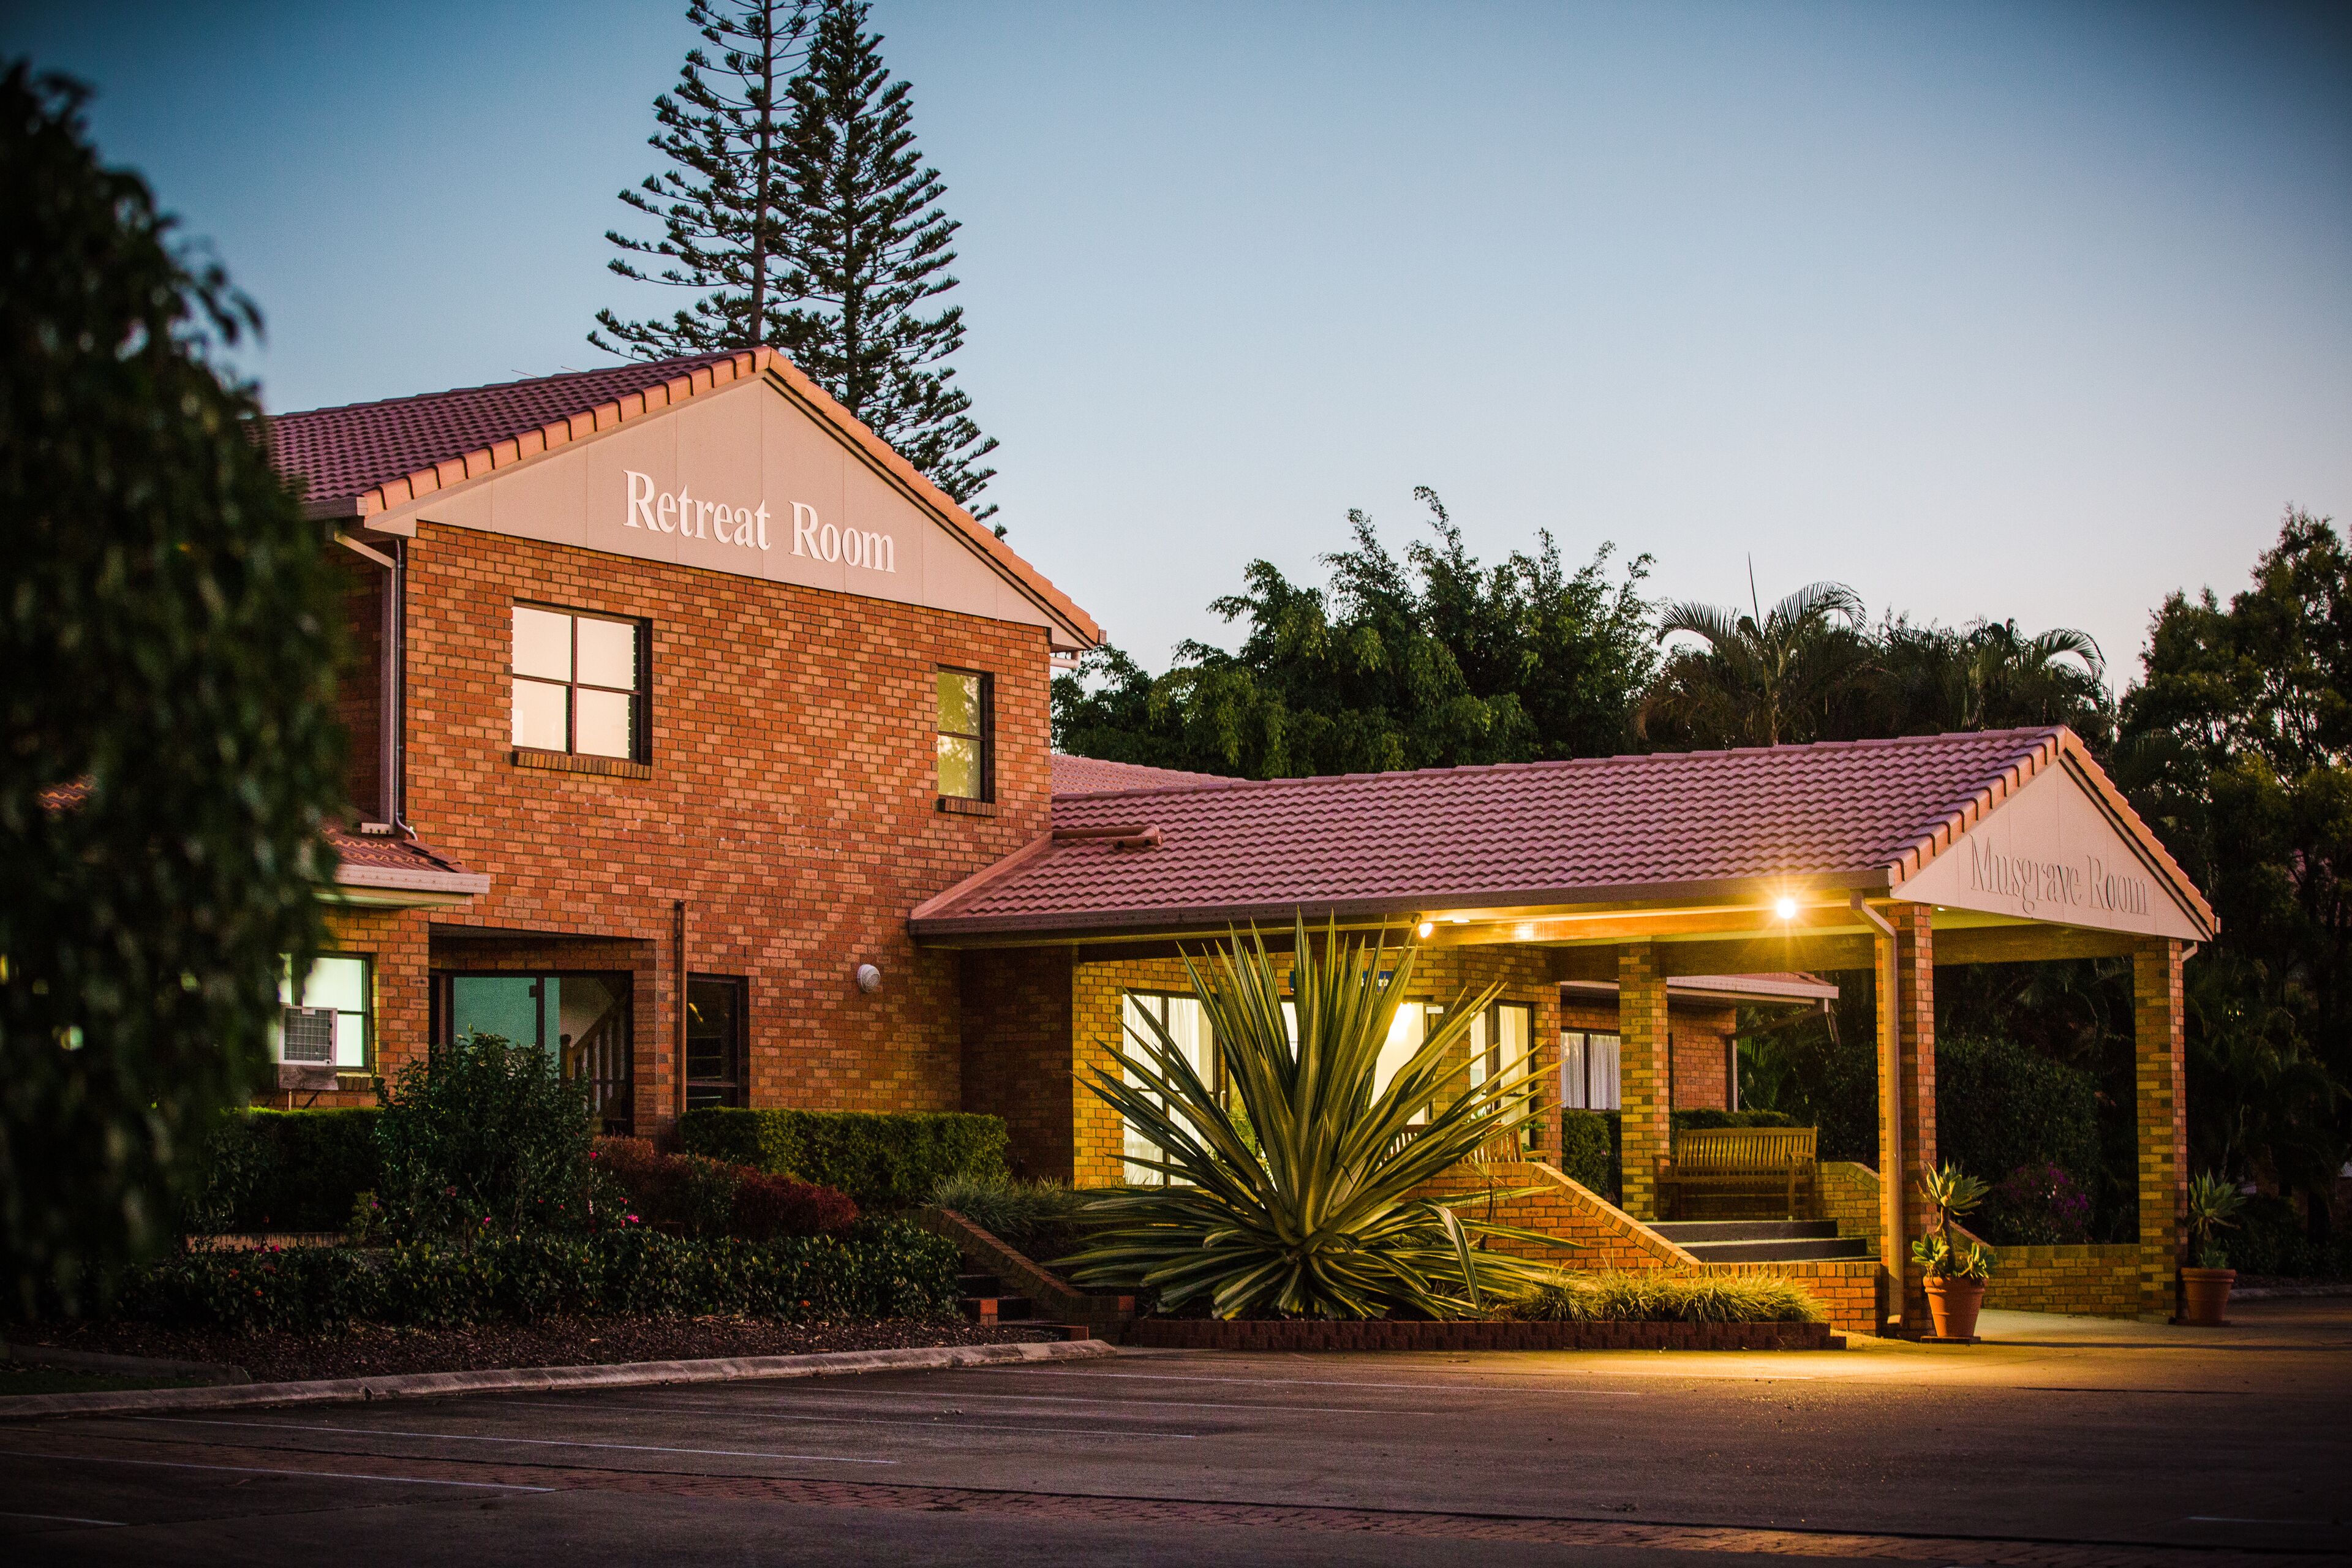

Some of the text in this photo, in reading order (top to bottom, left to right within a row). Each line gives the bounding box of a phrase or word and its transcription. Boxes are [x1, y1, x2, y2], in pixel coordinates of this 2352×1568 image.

[623, 470, 896, 573] Retreat Room
[1969, 834, 2150, 916] Musgrave Room
